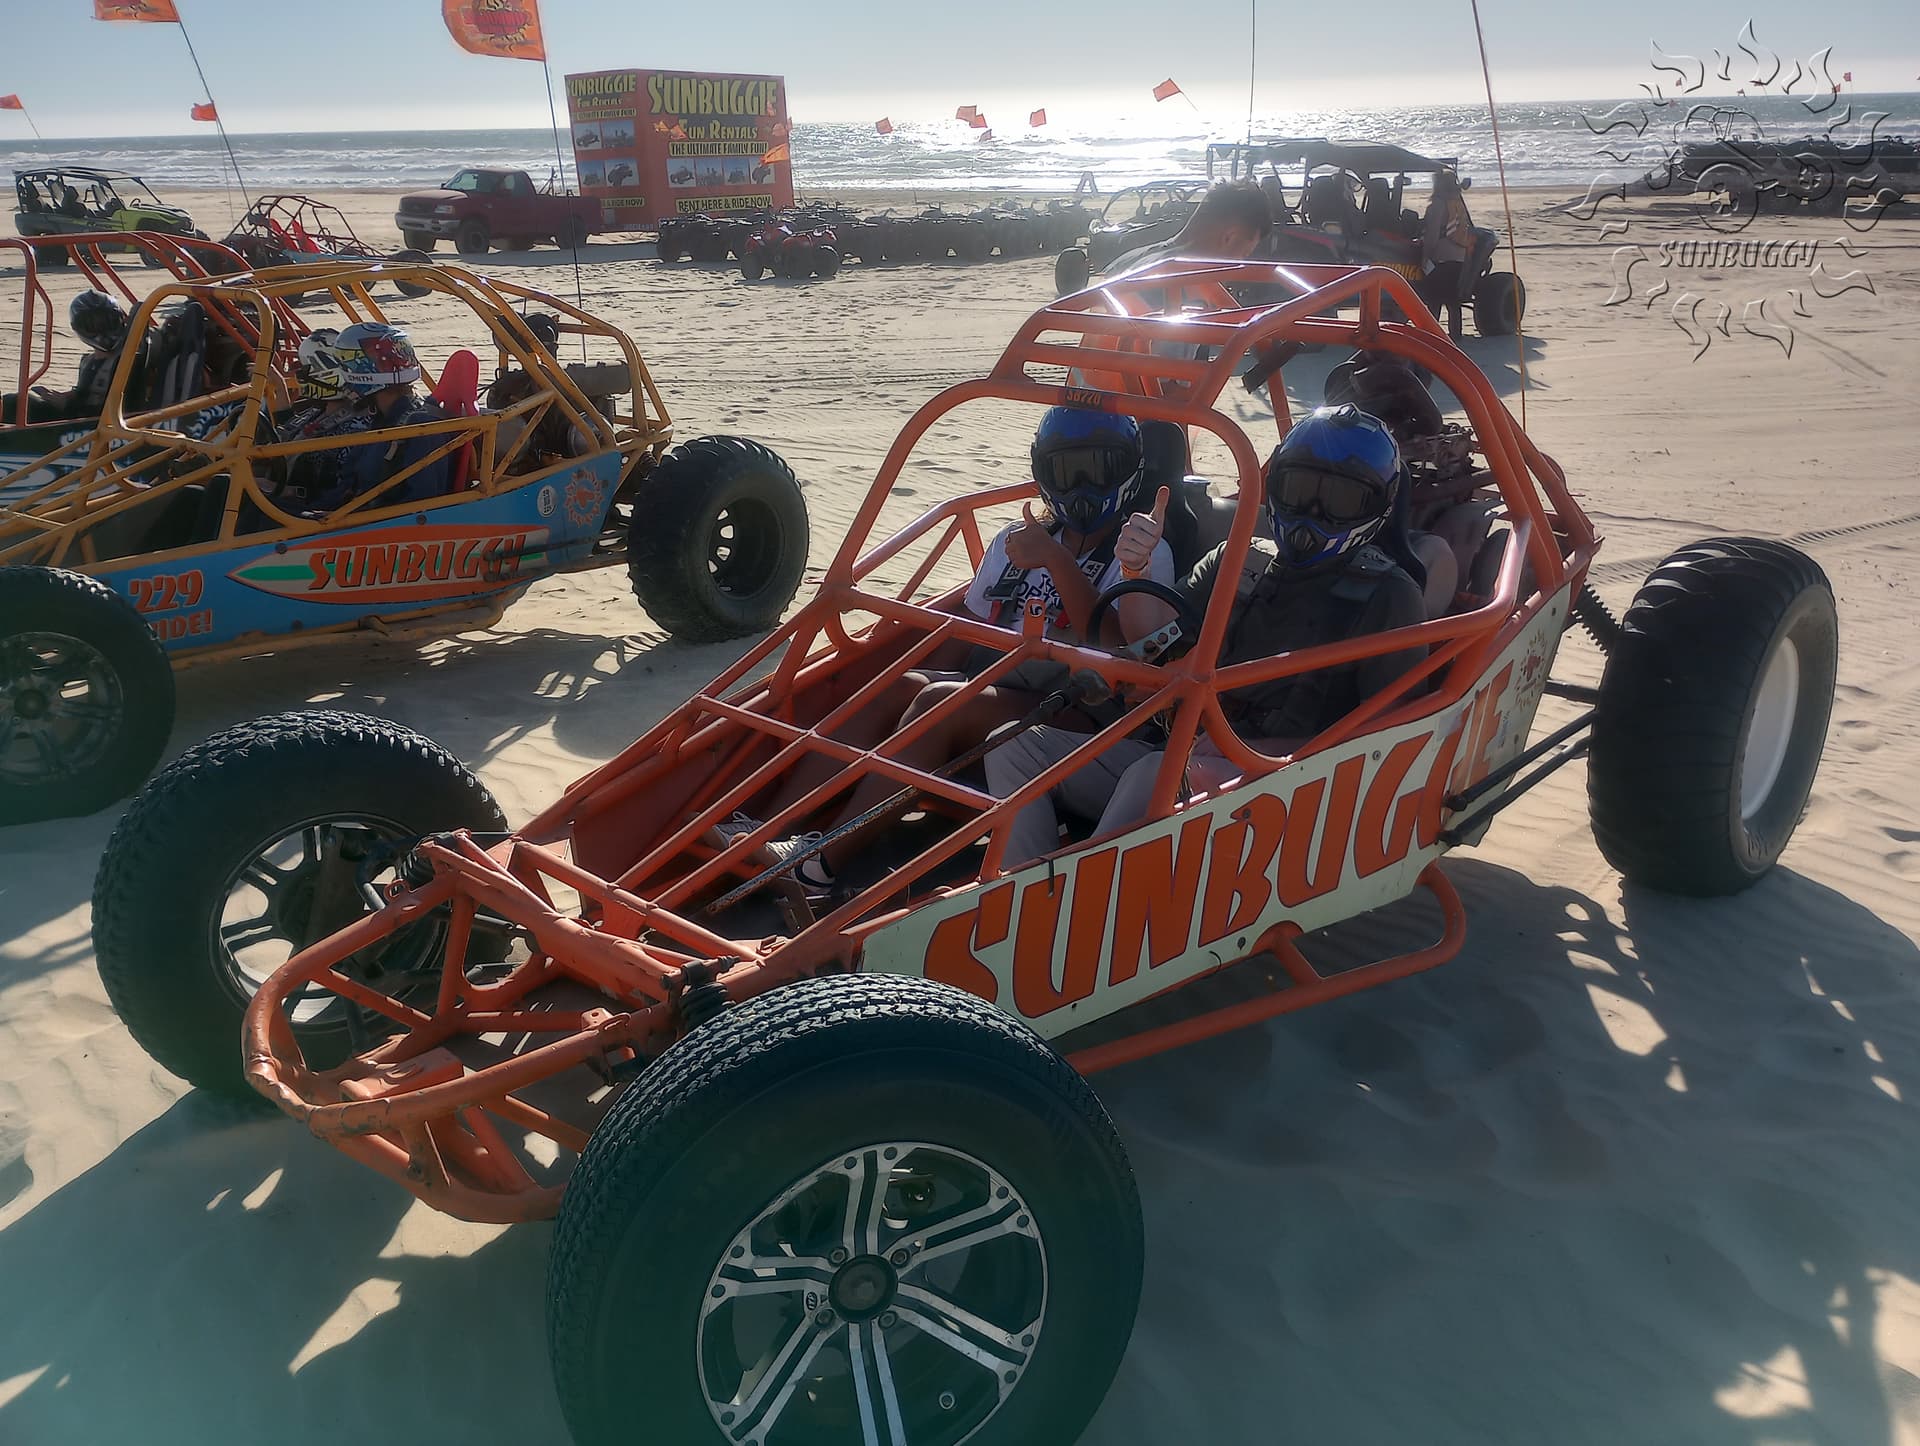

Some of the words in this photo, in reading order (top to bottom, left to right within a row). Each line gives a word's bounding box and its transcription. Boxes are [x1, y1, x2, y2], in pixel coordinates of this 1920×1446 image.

[647, 73, 777, 116] SUNBUGGIE
[678, 118, 705, 139] FUN
[709, 119, 758, 139] RENTALS
[671, 142, 686, 155] THE
[687, 142, 721, 155] ULTIMATE
[723, 142, 750, 155] FAMILY
[750, 142, 768, 155] FUN!
[625, 198, 643, 206] NOW
[678, 200, 700, 212] RENT
[701, 199, 723, 211] HERE
[724, 198, 731, 209] &
[732, 197, 750, 208] RIDE
[750, 196, 771, 208] NOW
[308, 534, 527, 591] SUNBUGGY
[128, 569, 204, 615] 229
